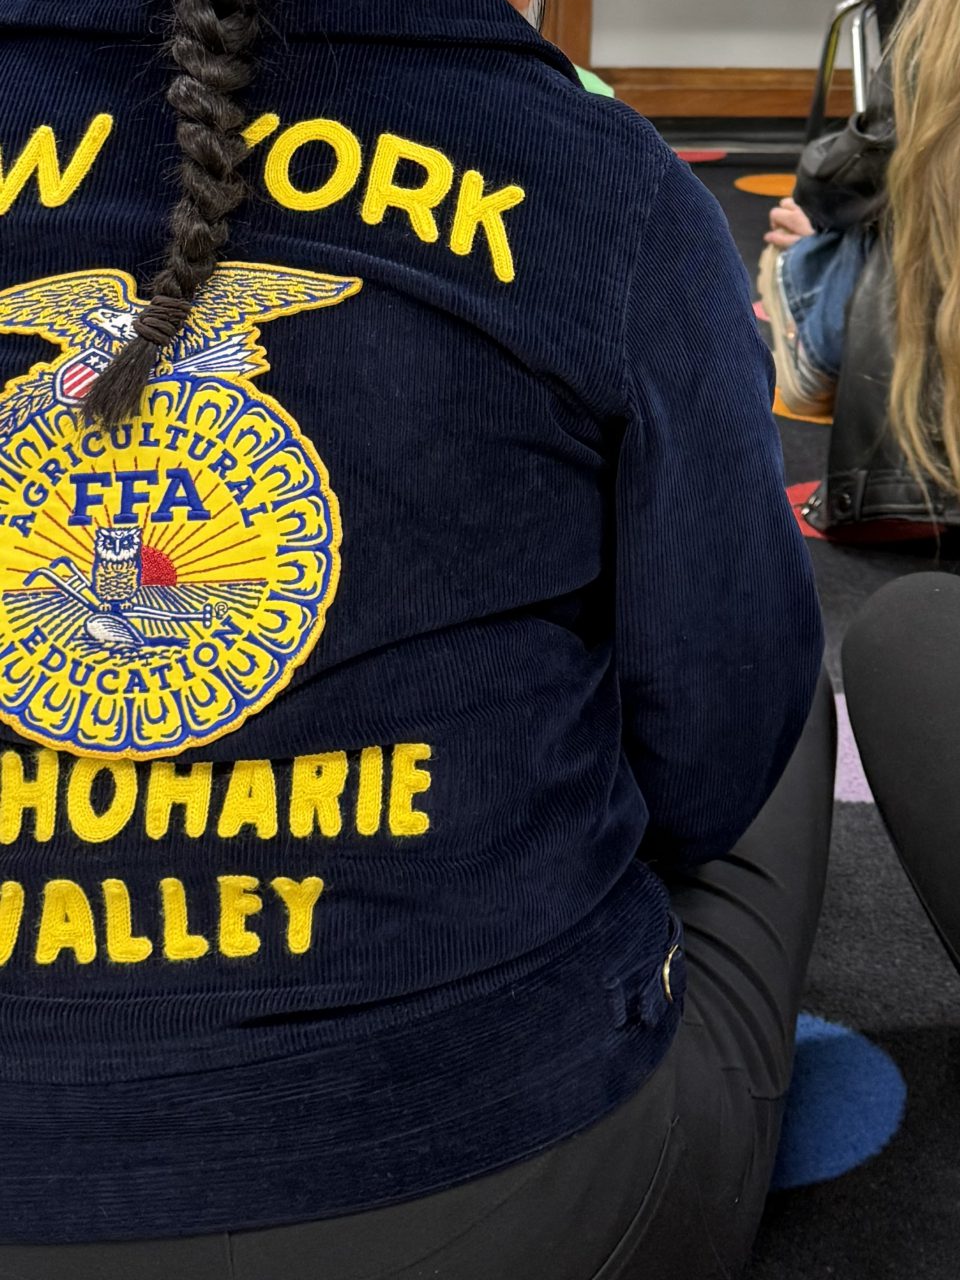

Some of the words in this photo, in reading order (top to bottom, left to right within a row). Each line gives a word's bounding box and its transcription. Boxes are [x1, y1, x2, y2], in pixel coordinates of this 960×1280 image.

[241, 113, 526, 283] ORK
[10, 422, 271, 538] AGRICULTURAL
[68, 467, 211, 526] FFA
[22, 617, 245, 695] EDUCATION
